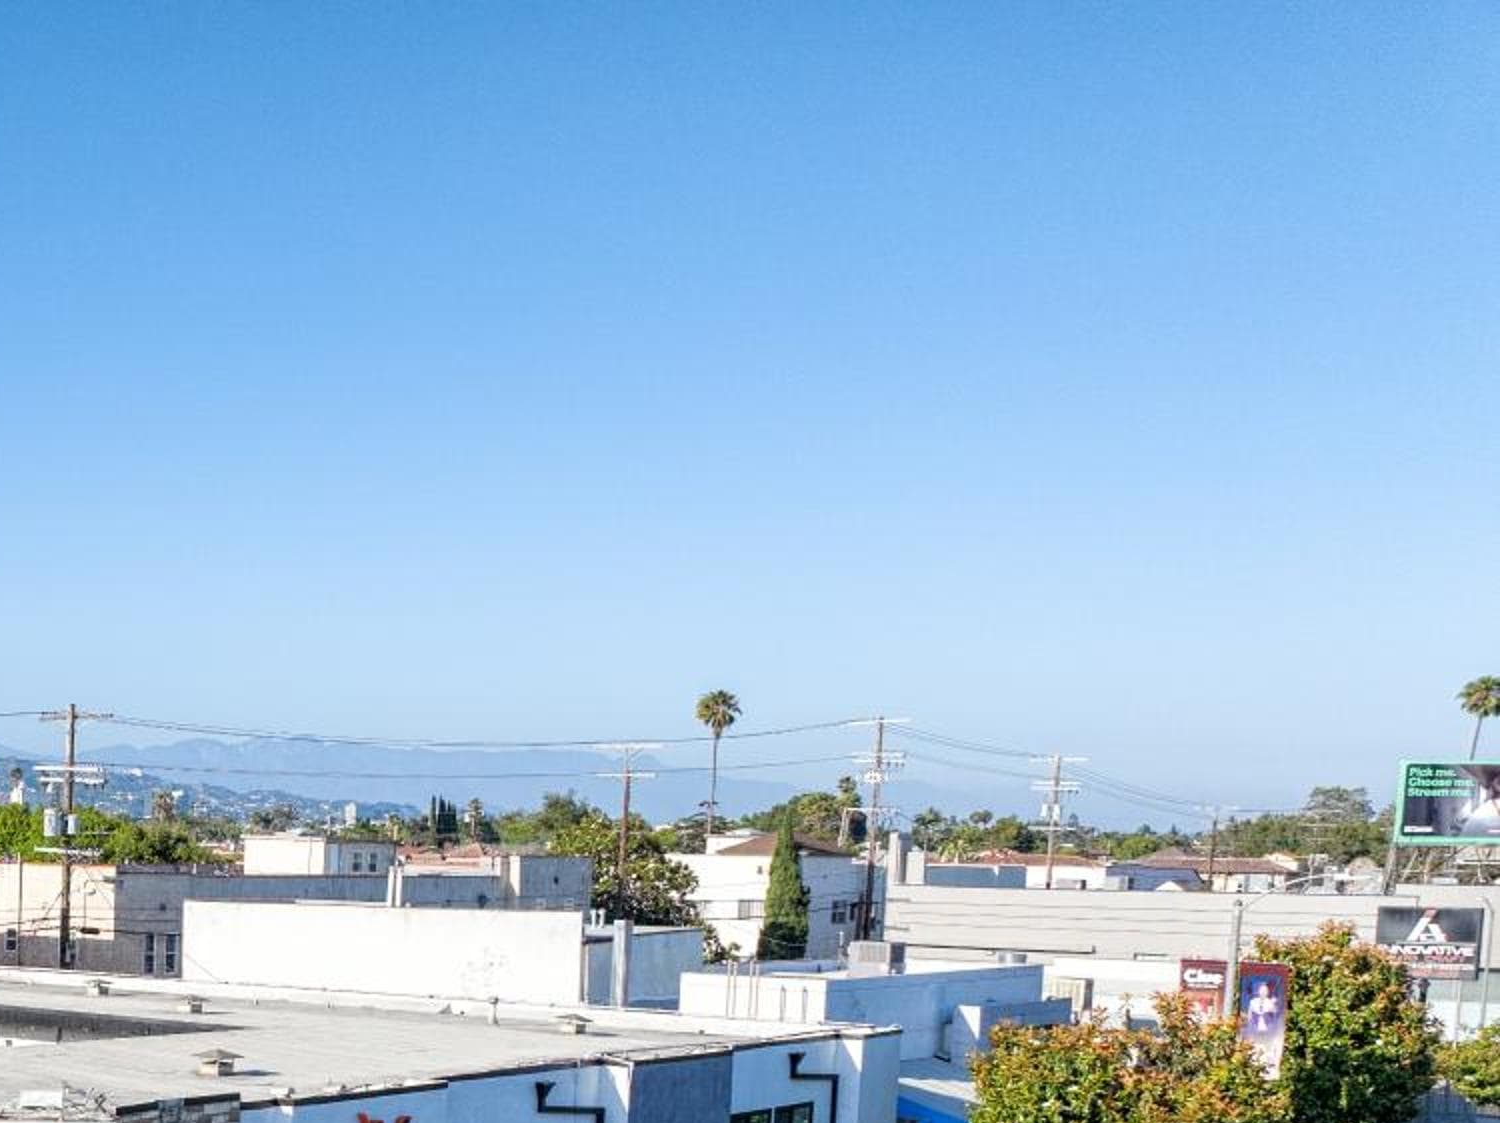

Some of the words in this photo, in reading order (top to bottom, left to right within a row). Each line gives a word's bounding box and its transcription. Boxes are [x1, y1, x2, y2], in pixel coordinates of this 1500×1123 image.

[1409, 767, 1433, 777] Pick
[1407, 777, 1453, 787] Choose
[1407, 787, 1448, 797] Stream
